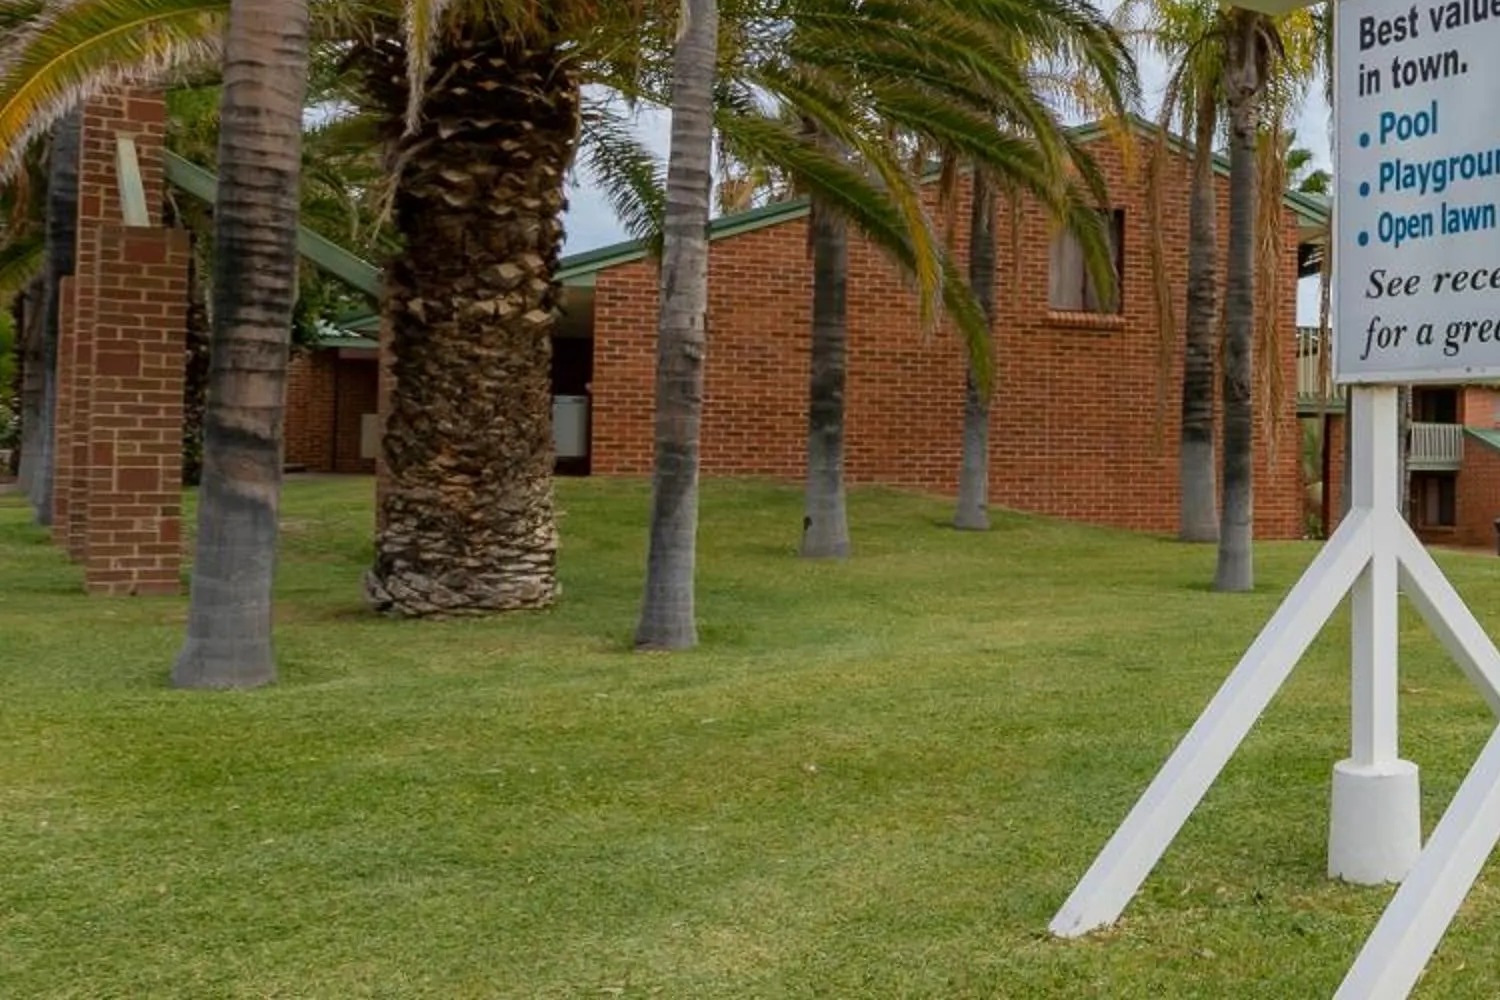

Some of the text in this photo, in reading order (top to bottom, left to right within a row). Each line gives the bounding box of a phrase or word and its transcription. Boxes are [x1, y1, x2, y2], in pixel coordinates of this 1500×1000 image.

[1359, 3, 1419, 51] Best
[1359, 48, 1468, 97] in town.
[1379, 100, 1438, 145] Pool
[1378, 211, 1433, 248] Open
[1441, 203, 1495, 235] lawn
[1365, 268, 1420, 299] See
[1360, 315, 1407, 360] for
[1416, 323, 1433, 346] a
